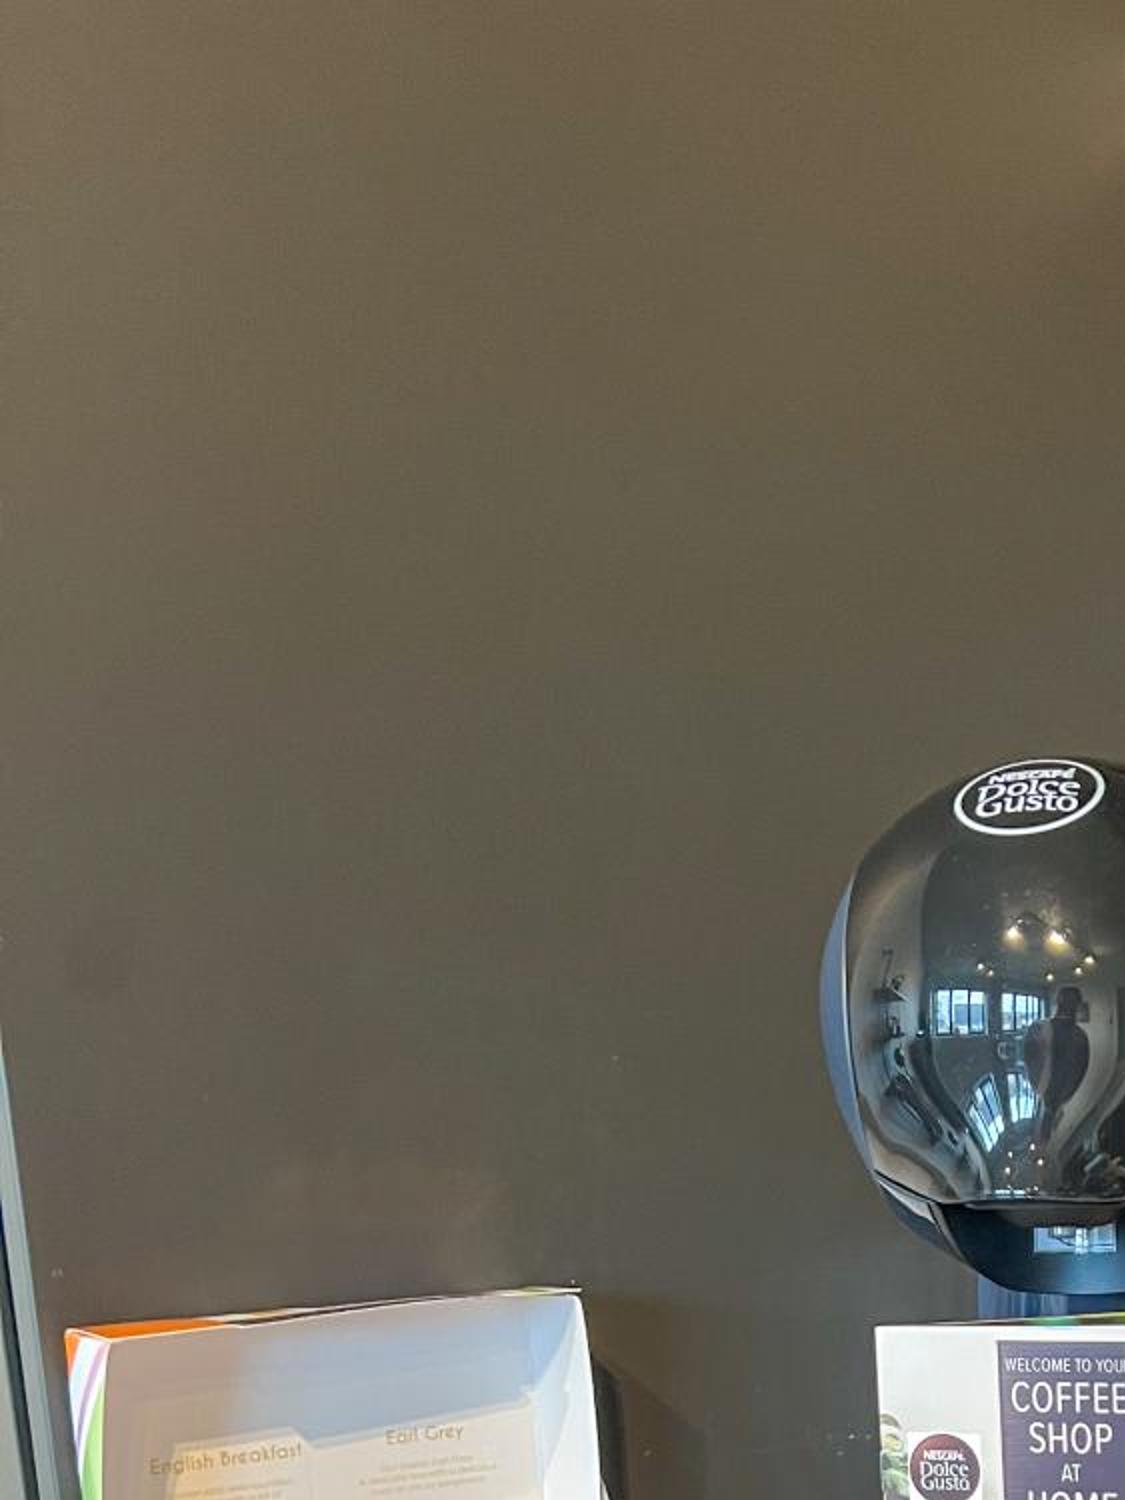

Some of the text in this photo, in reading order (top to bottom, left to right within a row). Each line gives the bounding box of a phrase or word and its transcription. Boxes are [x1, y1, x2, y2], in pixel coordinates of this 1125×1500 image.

[977, 780, 1081, 803] Dolce
[975, 795, 1080, 818] Gusto
[1004, 1357, 1071, 1373] WELCOME
[1075, 1358, 1091, 1373] TO
[384, 1424, 465, 1445] Earl Grey
[1028, 1421, 1113, 1455] SHOP
[149, 1443, 303, 1475] English Breakfast
[920, 1460, 970, 1478] Dolce
[921, 1474, 970, 1491] Gusto
[1061, 1463, 1082, 1483] AT
